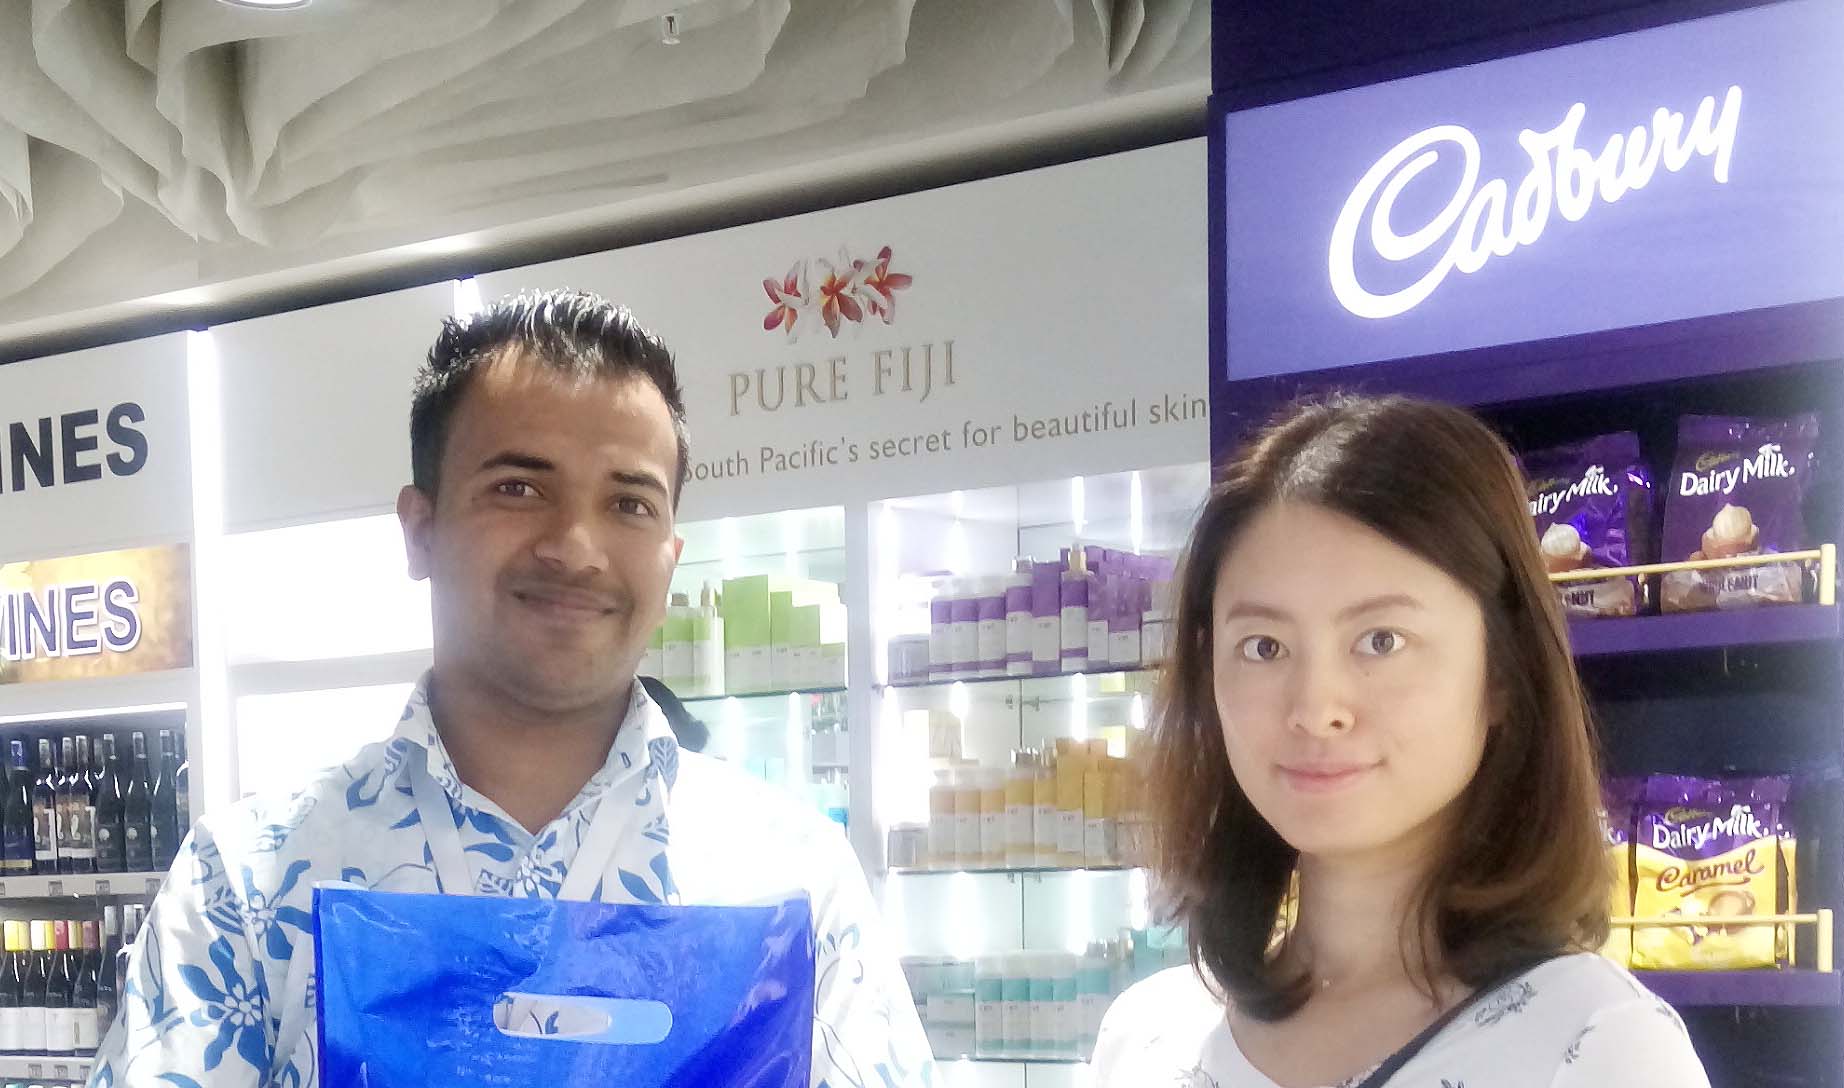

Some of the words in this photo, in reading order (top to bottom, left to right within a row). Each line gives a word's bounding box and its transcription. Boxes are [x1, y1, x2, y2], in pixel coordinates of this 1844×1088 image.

[1328, 84, 1743, 319] Cadbury
[728, 354, 849, 417] PURE
[872, 339, 958, 402] FIJI
[0, 401, 149, 494] NES
[760, 436, 859, 474] Pacific's
[868, 428, 952, 461] secret
[962, 420, 1002, 448] for
[1012, 398, 1137, 442] beautiful
[1149, 393, 1208, 425] skin
[1679, 466, 1741, 496] Dairy
[1742, 444, 1790, 484] Milk
[1566, 465, 1614, 502] Milk
[0, 577, 142, 661] INES
[1653, 822, 1712, 850] Dairy
[1712, 803, 1762, 839] Milk
[1655, 848, 1765, 893] Caramel
